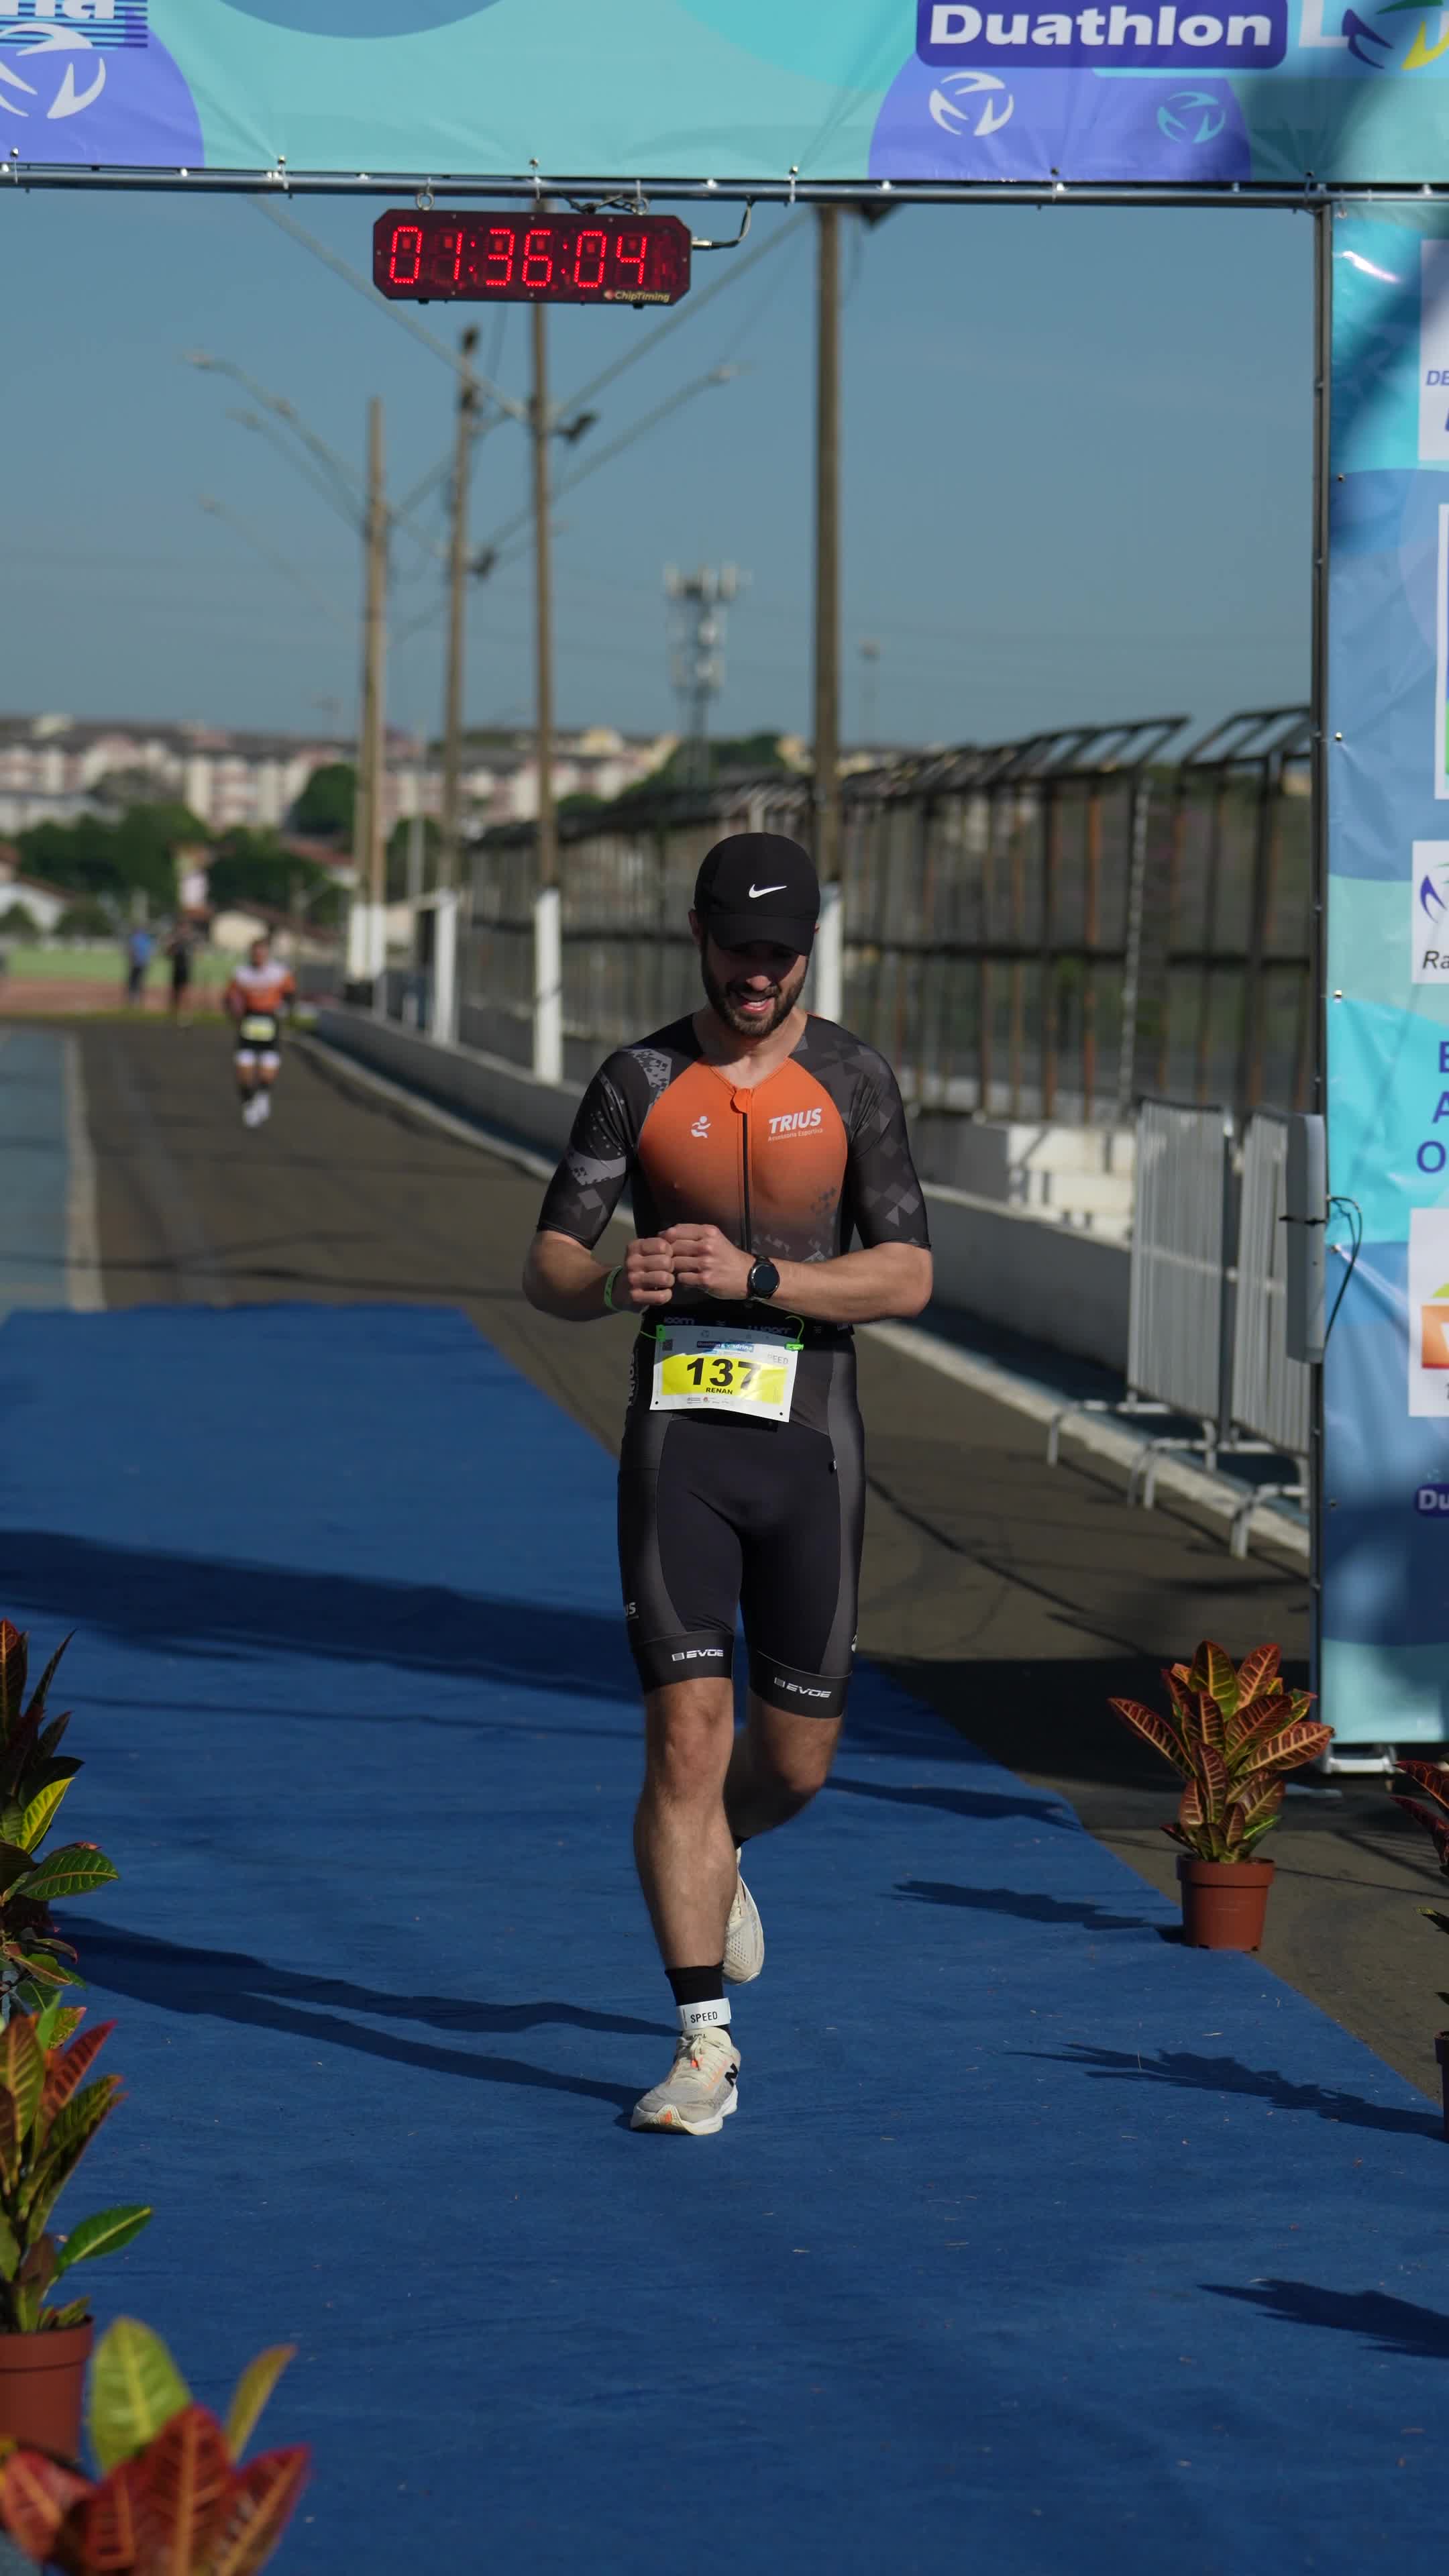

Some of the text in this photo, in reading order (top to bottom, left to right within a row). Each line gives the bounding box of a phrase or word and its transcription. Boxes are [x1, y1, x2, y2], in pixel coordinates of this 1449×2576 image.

[930, 5, 1272, 46] Duathlon
[388, 226, 647, 288] 01:36:04
[614, 290, 671, 303] ChipTiming
[769, 1108, 822, 1134] TRIUS
[687, 1358, 761, 1390] 137
[690, 2011, 718, 2023] SPEED
